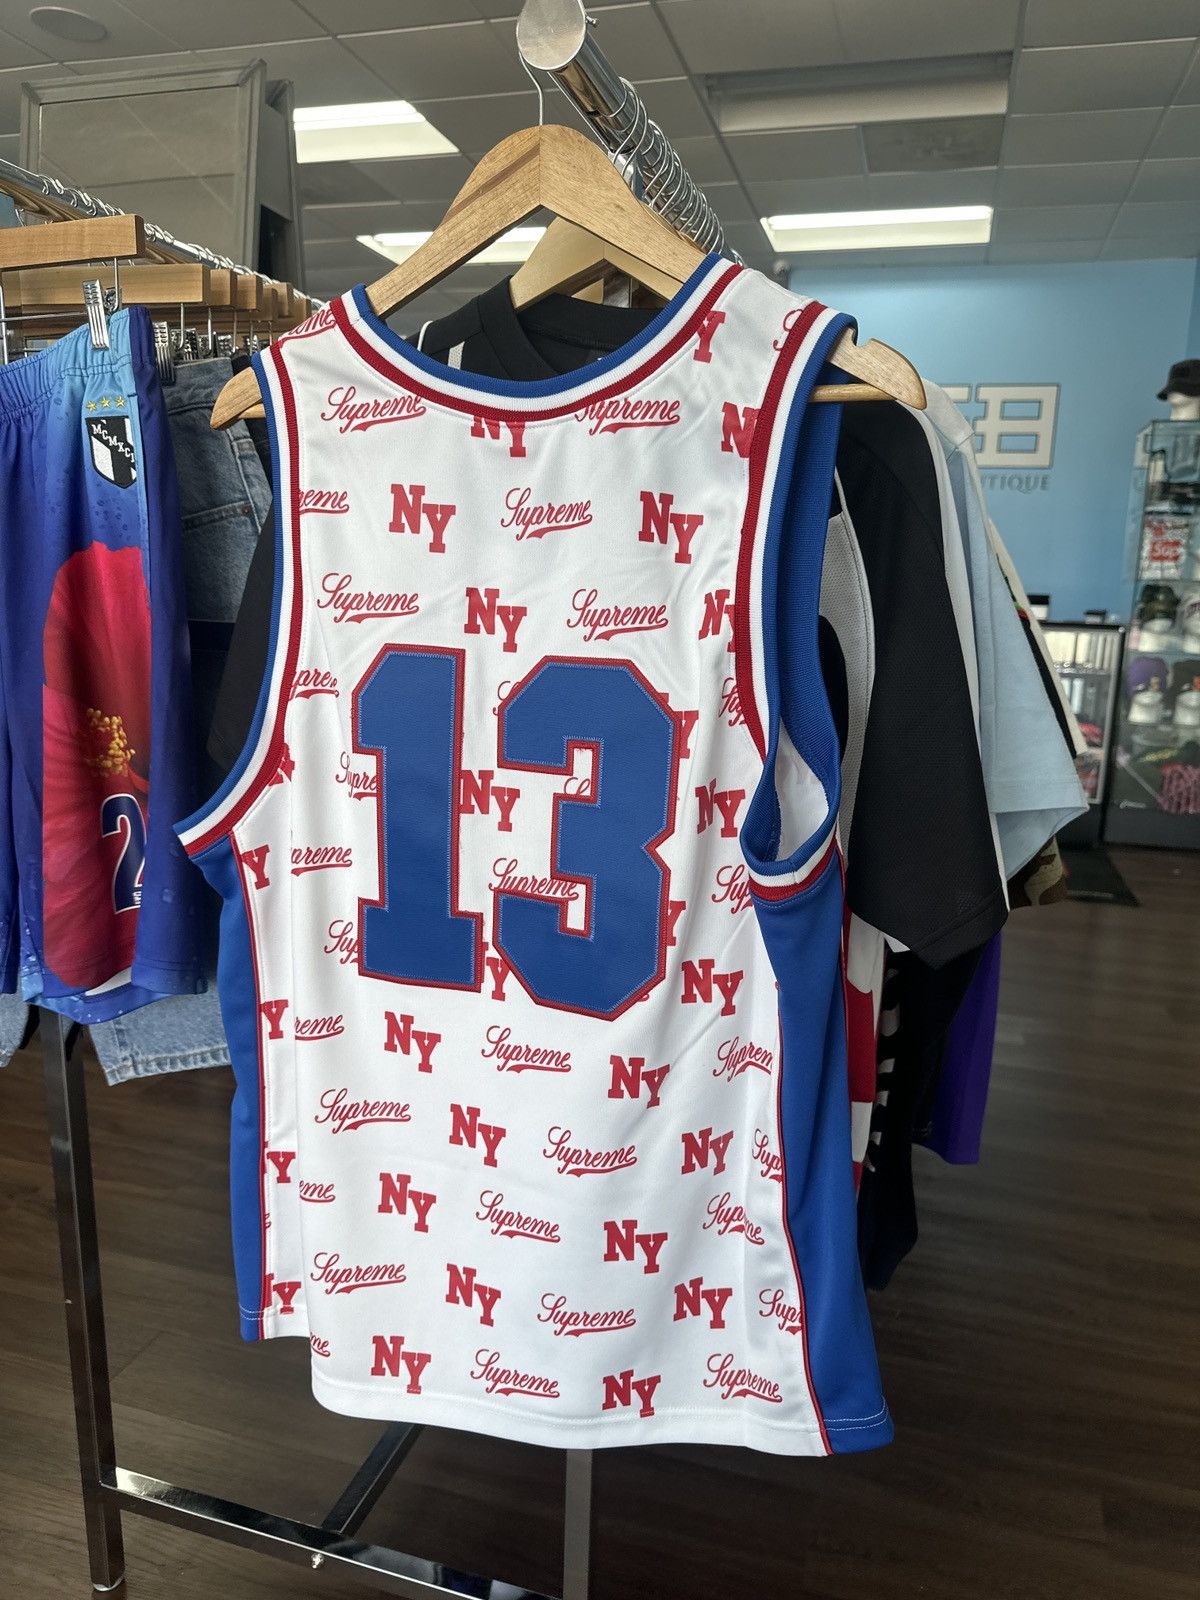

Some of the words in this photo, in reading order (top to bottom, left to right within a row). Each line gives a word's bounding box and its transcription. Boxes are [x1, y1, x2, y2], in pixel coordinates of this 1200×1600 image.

[693, 310, 726, 363] Y
[321, 387, 426, 433] Supreme
[721, 402, 761, 458] N
[982, 474, 1052, 494] TIQUE
[389, 483, 456, 554] NY
[500, 486, 593, 542] Supreme
[638, 491, 704, 565] NY
[316, 573, 419, 623] Supreme
[464, 587, 528, 653] NY
[566, 588, 669, 641] Supreme
[335, 751, 377, 801] Supre
[459, 770, 521, 832] NY
[352, 643, 683, 1022] 13
[695, 778, 746, 838] NY
[241, 844, 271, 890] Y
[681, 959, 744, 1017] NY
[261, 999, 289, 1040] Y
[384, 1011, 442, 1073] NY
[481, 1025, 572, 1074] Supreme
[608, 1055, 670, 1108] NY
[314, 1088, 412, 1134] Supreme
[449, 1104, 506, 1168] NY
[265, 1141, 297, 1184] Y
[542, 1126, 637, 1177] Supreme
[681, 1127, 734, 1176] NY
[378, 1172, 437, 1233] NY
[475, 1190, 561, 1243] Supreme
[310, 1252, 407, 1294] Supreme
[603, 1219, 668, 1274] NY
[445, 1264, 501, 1327] NY
[537, 1293, 637, 1337] Supreme
[673, 1276, 733, 1329] NY
[370, 1335, 433, 1395] NY
[470, 1348, 560, 1398] Supreme
[703, 1353, 783, 1403] Supreme
[602, 1369, 661, 1418] NY
